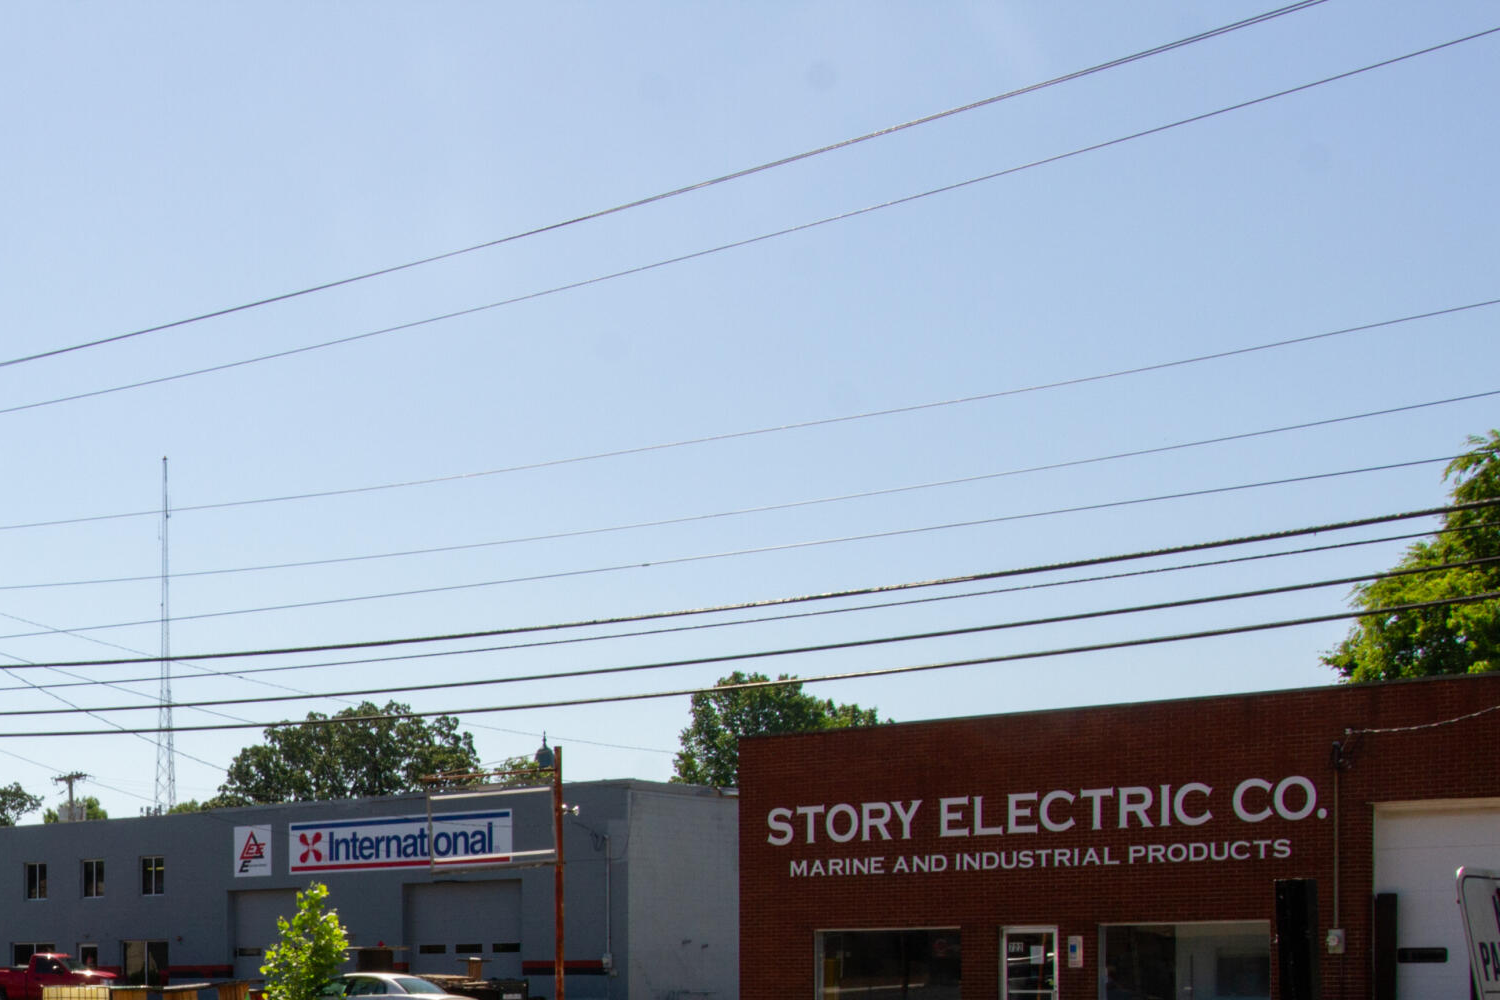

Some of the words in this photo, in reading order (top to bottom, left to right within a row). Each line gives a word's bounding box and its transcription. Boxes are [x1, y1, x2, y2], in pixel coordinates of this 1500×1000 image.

[767, 799, 923, 846] STORY
[939, 782, 1213, 837] ELECTRIC
[1232, 775, 1328, 823] CO.
[789, 856, 885, 878] MARINE
[892, 854, 948, 873] AND
[955, 848, 1120, 871] INDUSTRIAL
[1128, 839, 1292, 864] PRODUCTS
[1479, 942, 1500, 981] PA
